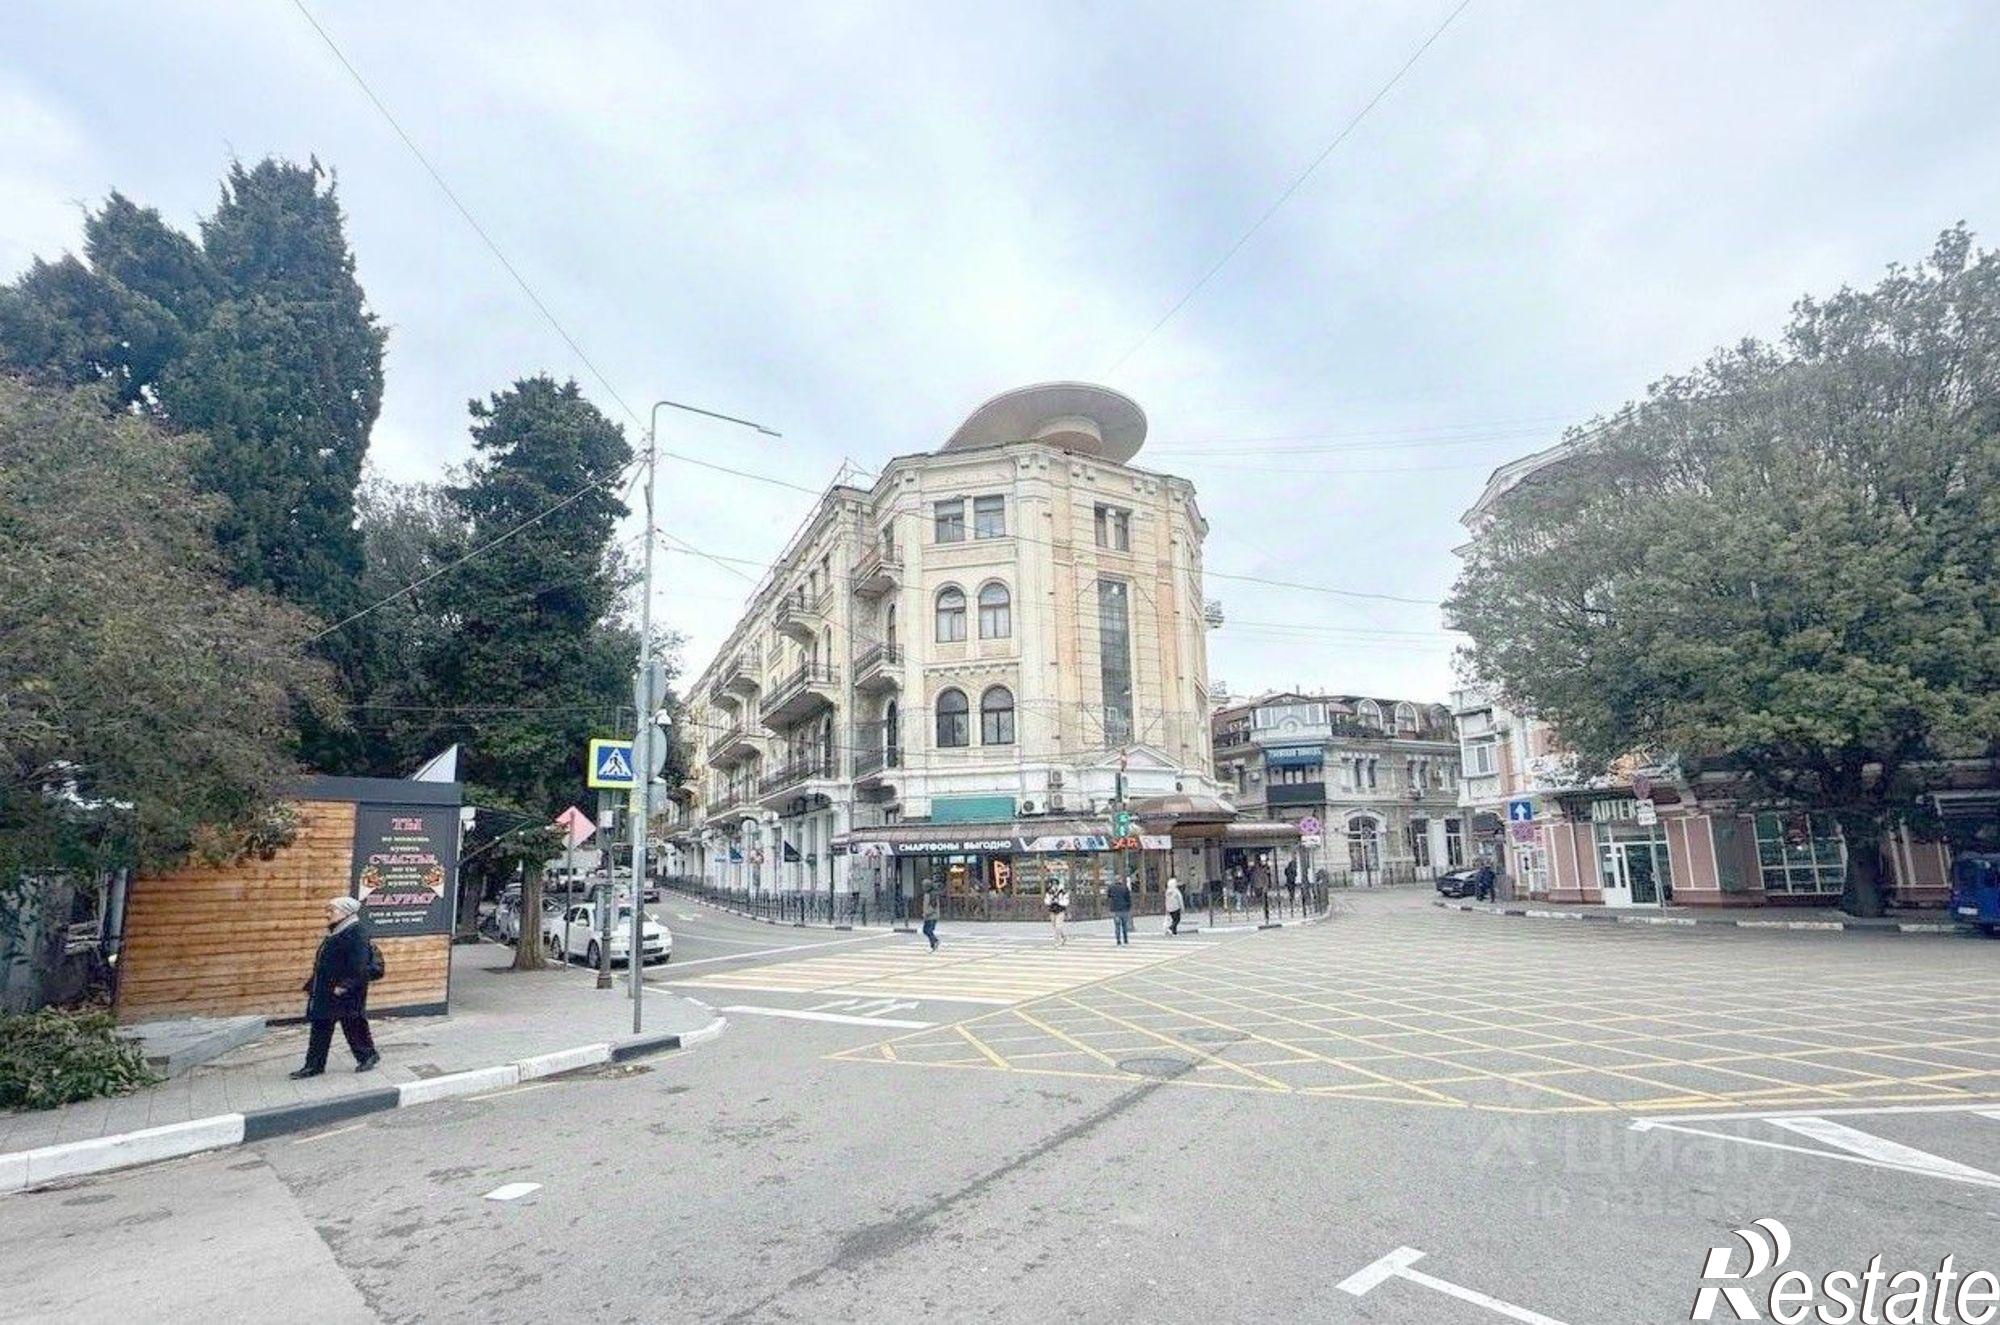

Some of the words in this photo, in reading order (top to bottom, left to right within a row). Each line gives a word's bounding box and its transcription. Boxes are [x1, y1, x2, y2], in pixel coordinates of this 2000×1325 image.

[1592, 799, 1636, 822] АПТЕК
[392, 818, 422, 831] ТЫ
[899, 842, 959, 852] СМАРТФОНЫ
[963, 840, 1012, 852] ВЫГОДНО
